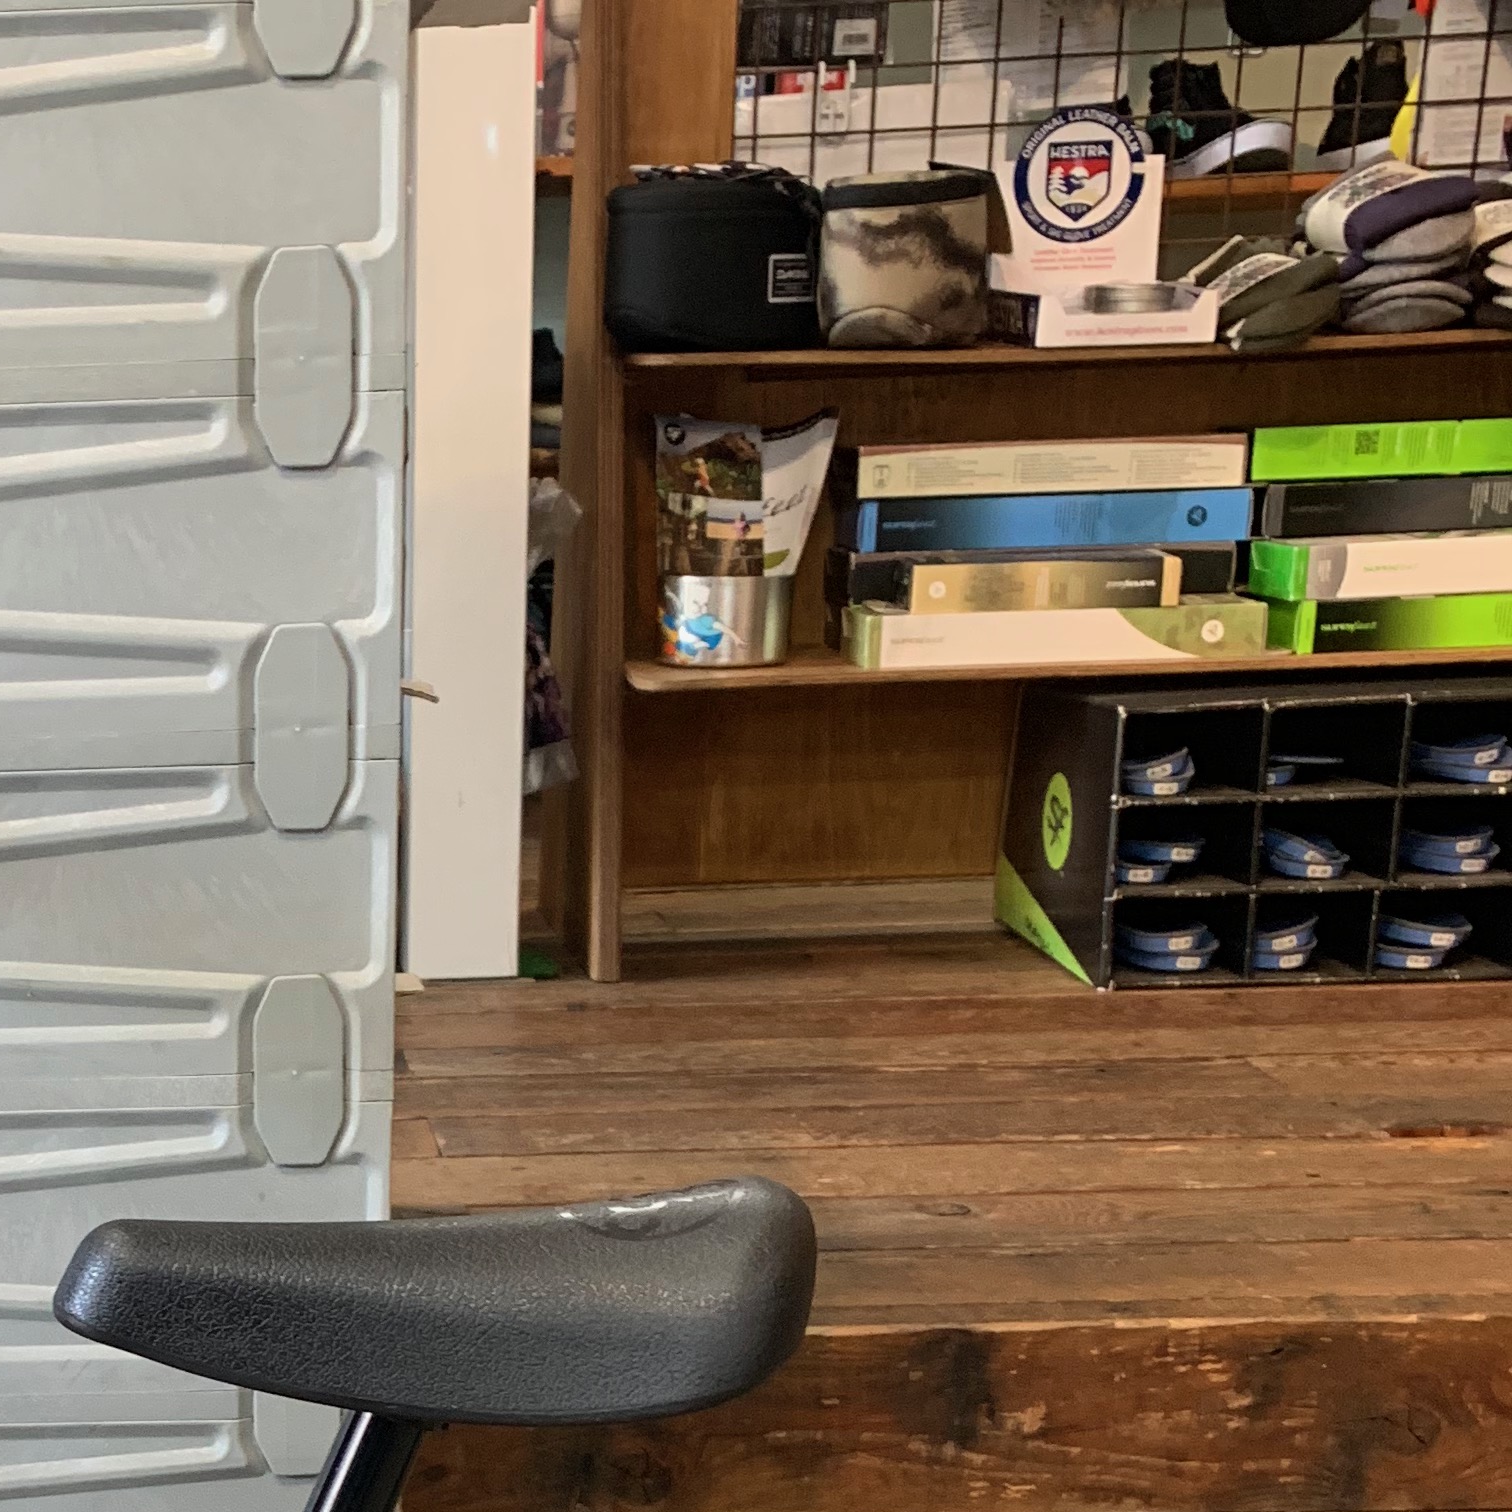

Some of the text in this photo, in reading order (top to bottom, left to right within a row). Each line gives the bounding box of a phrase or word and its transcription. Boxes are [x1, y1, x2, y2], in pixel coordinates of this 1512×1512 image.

[1021, 114, 1066, 159] ORIGINAL
[1068, 108, 1118, 127] LEATHER
[1049, 144, 1109, 158] HESTRA
